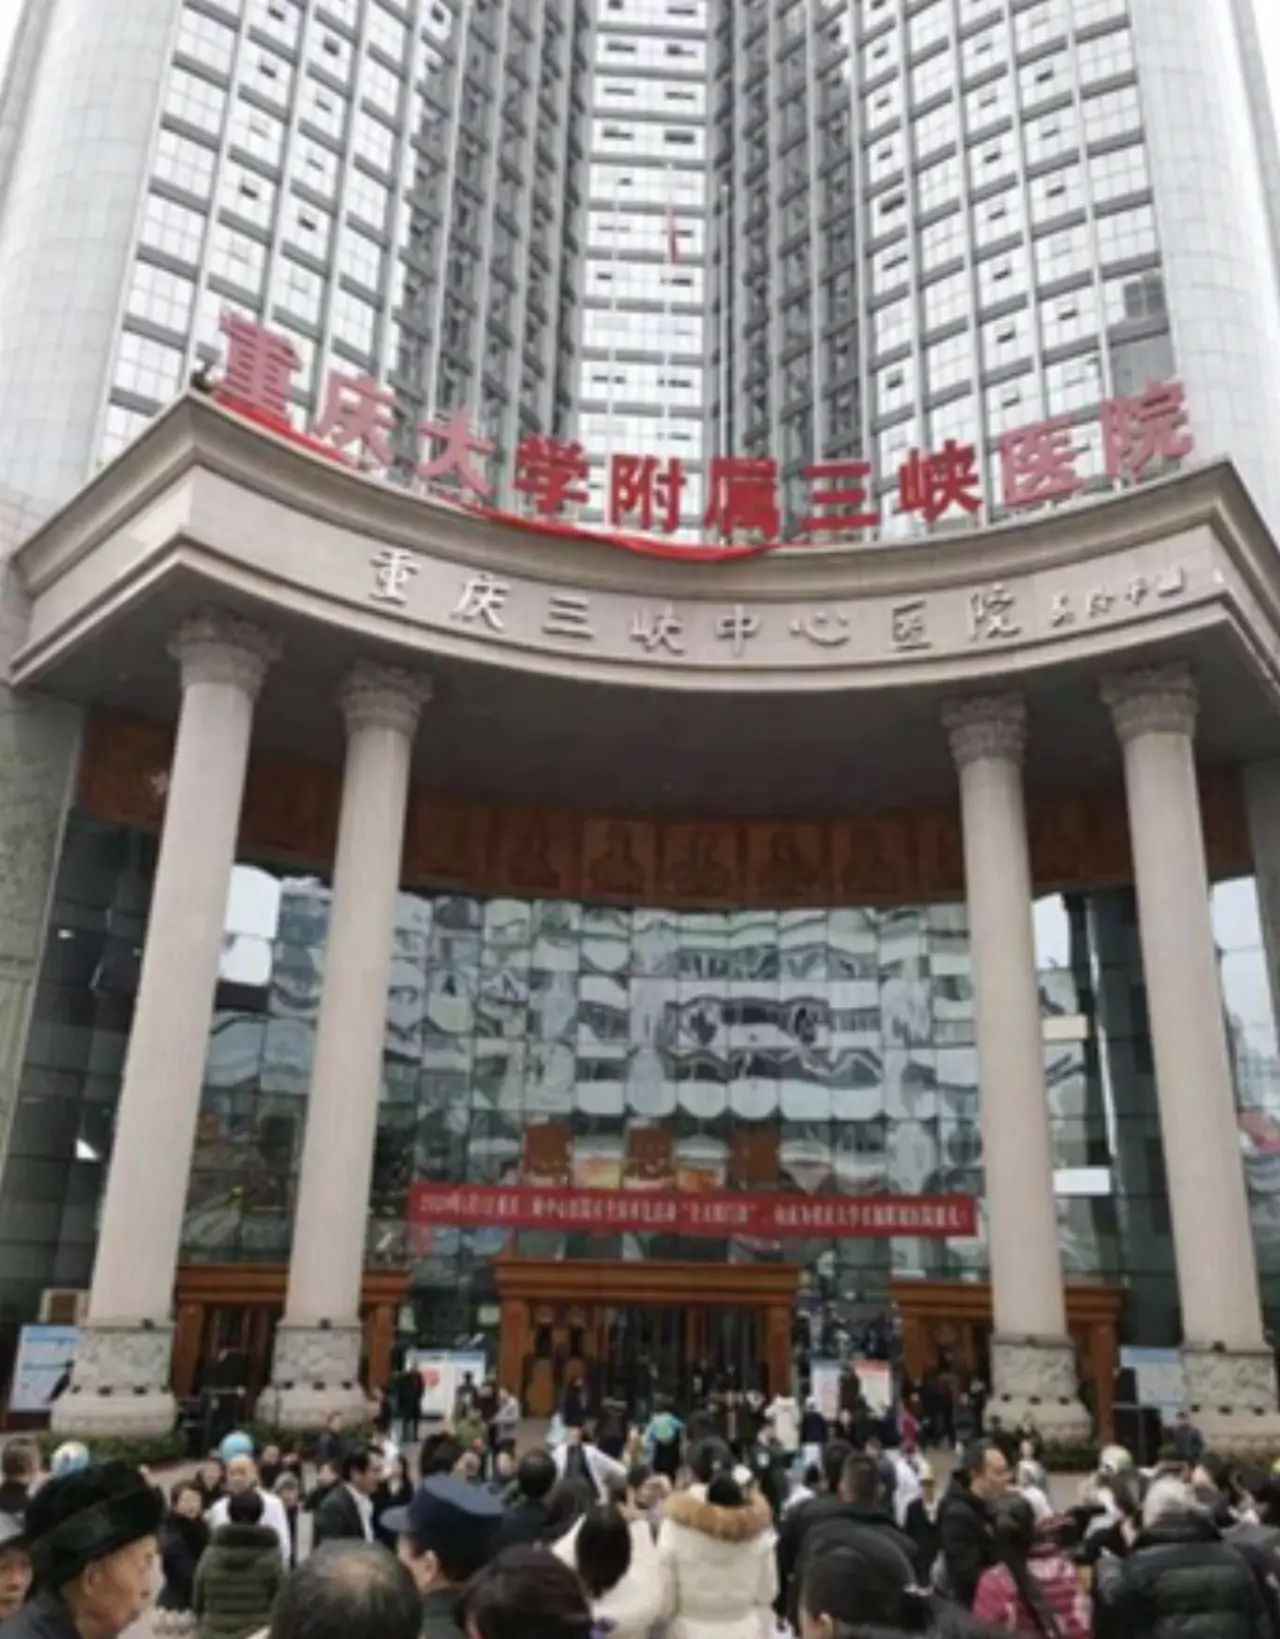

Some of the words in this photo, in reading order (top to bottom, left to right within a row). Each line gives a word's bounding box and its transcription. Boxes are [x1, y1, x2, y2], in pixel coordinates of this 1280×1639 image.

[217, 312, 1194, 539] 重庆大学附属三峡医院
[369, 547, 1021, 657] 重庆三峡中心医院
